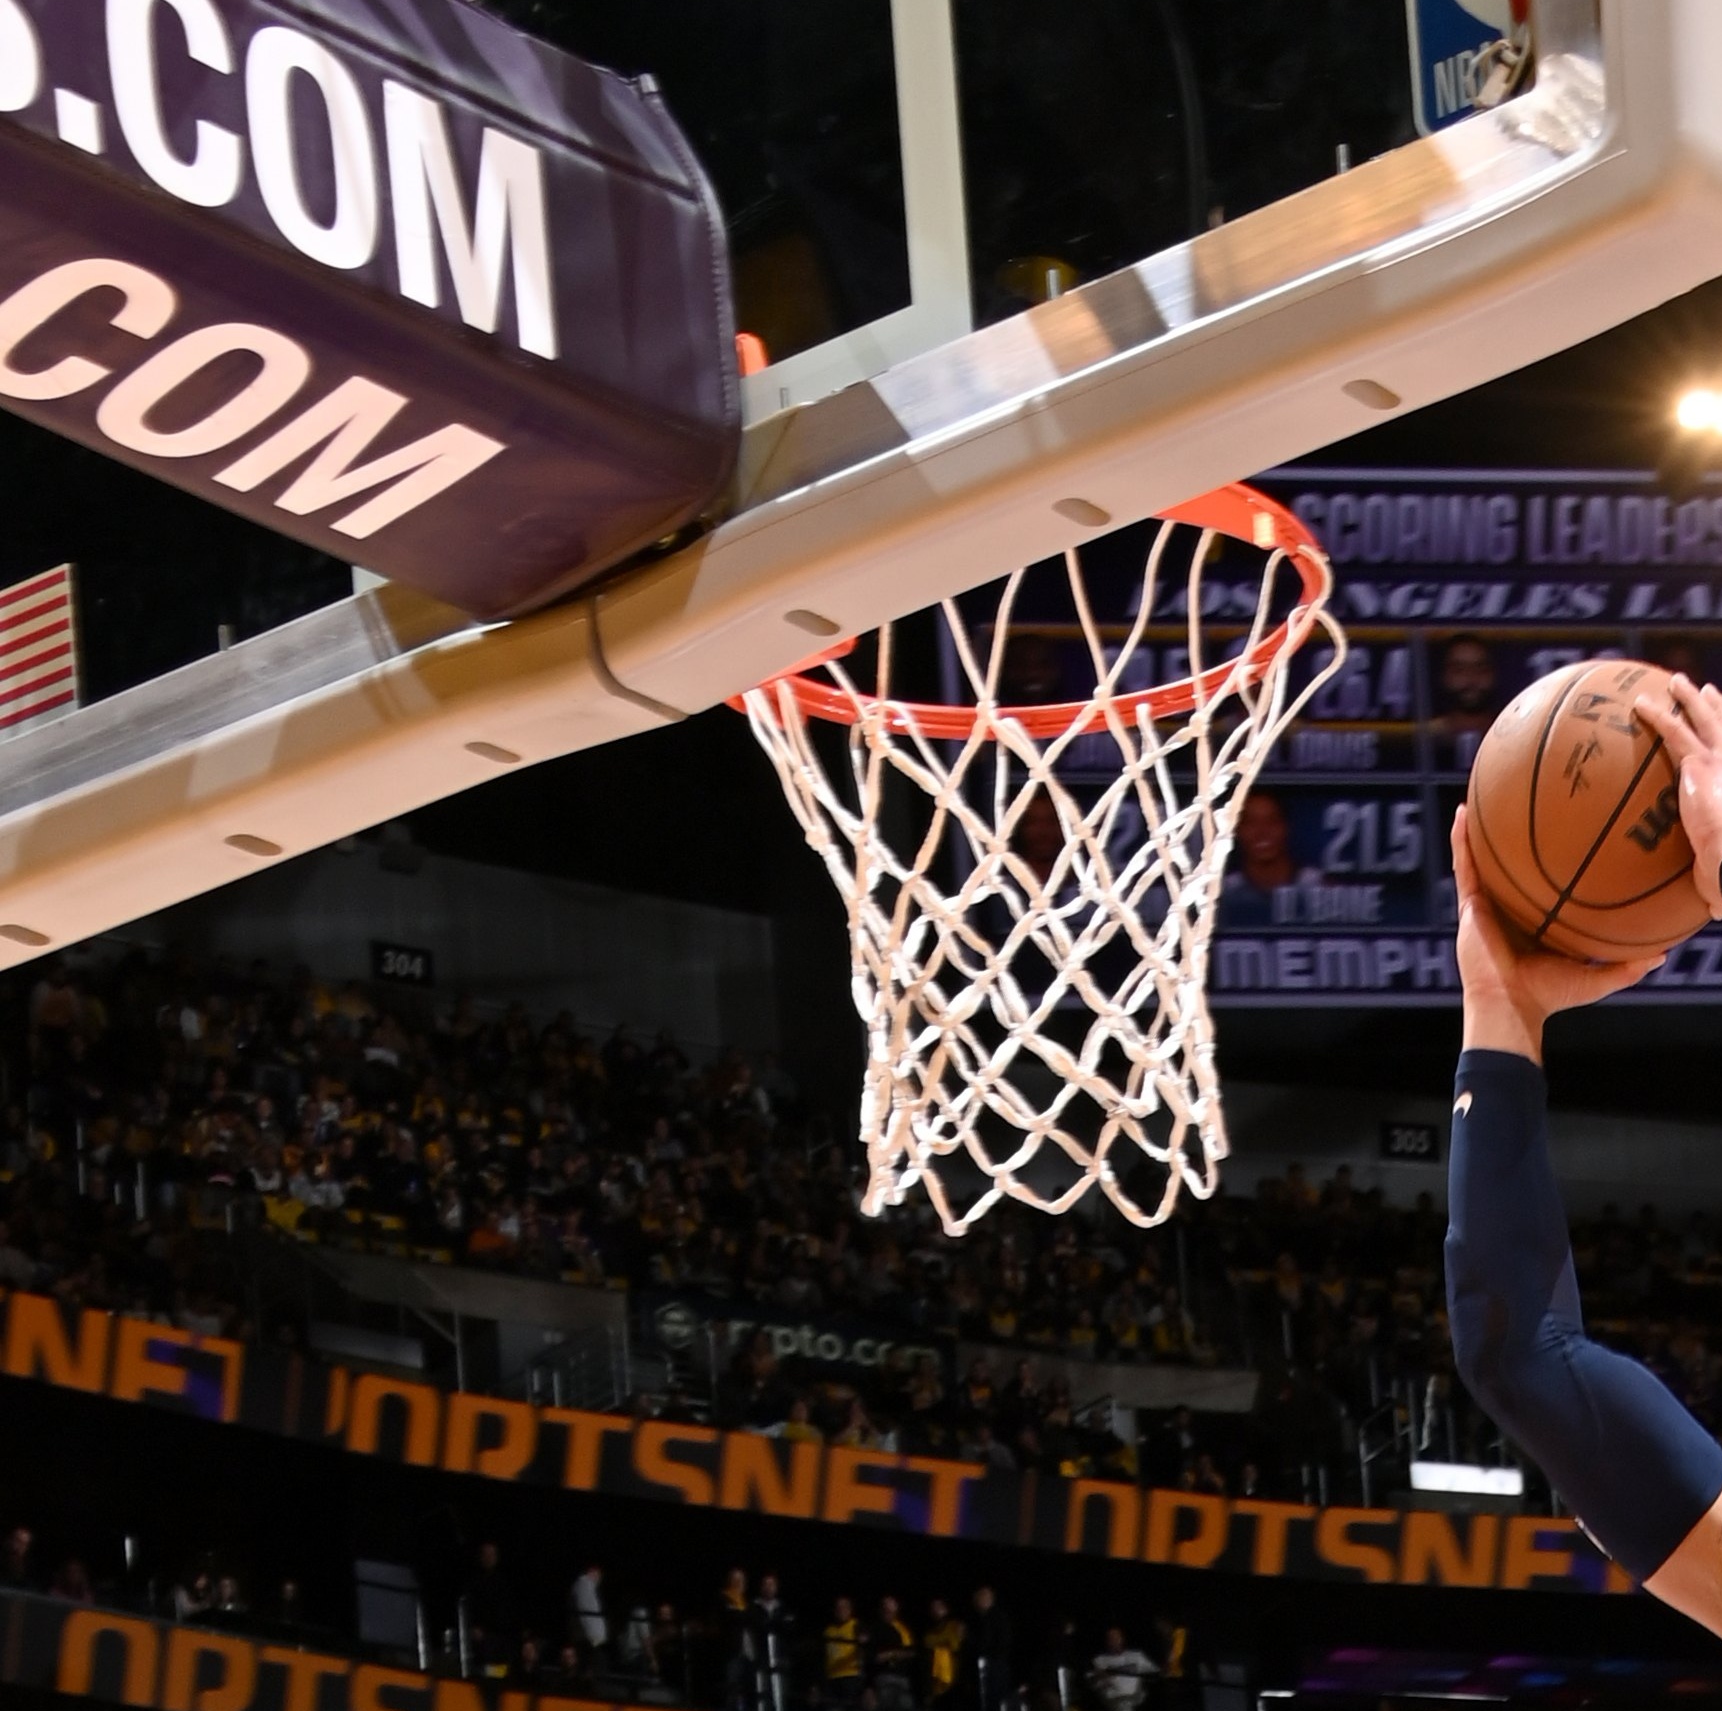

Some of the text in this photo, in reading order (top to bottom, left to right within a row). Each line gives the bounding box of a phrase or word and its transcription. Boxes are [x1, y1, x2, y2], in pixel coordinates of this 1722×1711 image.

[0, 258, 508, 541] COM
[1332, 580, 1611, 620] NGELES
[1216, 938, 1461, 991] MEMPH
